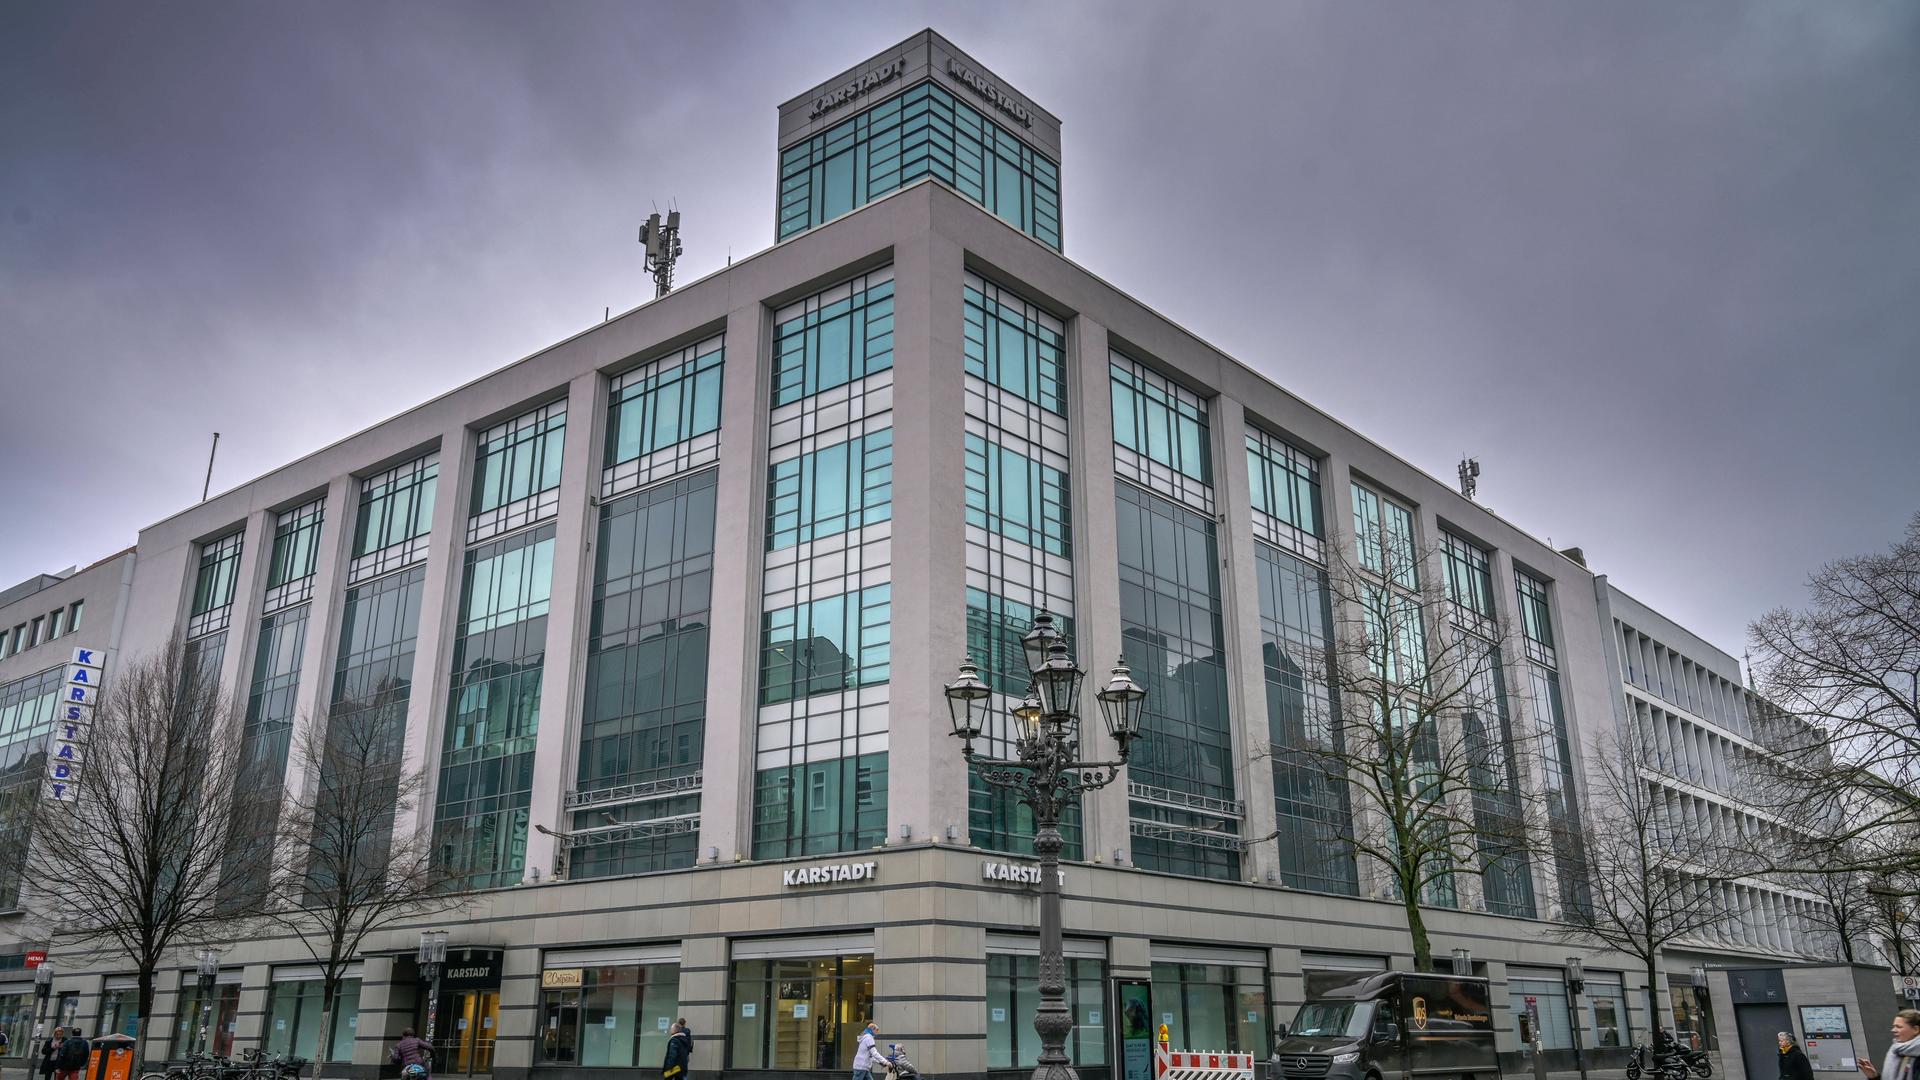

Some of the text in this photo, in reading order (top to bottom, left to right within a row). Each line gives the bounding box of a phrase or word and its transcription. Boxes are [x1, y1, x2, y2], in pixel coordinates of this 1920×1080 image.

[810, 60, 904, 116] KARSTADT
[948, 58, 1034, 128] KARSTADT
[52, 650, 93, 799] KARSTADT
[783, 861, 876, 886] KARSTADT
[985, 862, 1065, 886] KARSTT
[448, 967, 490, 979] KARSTADT
